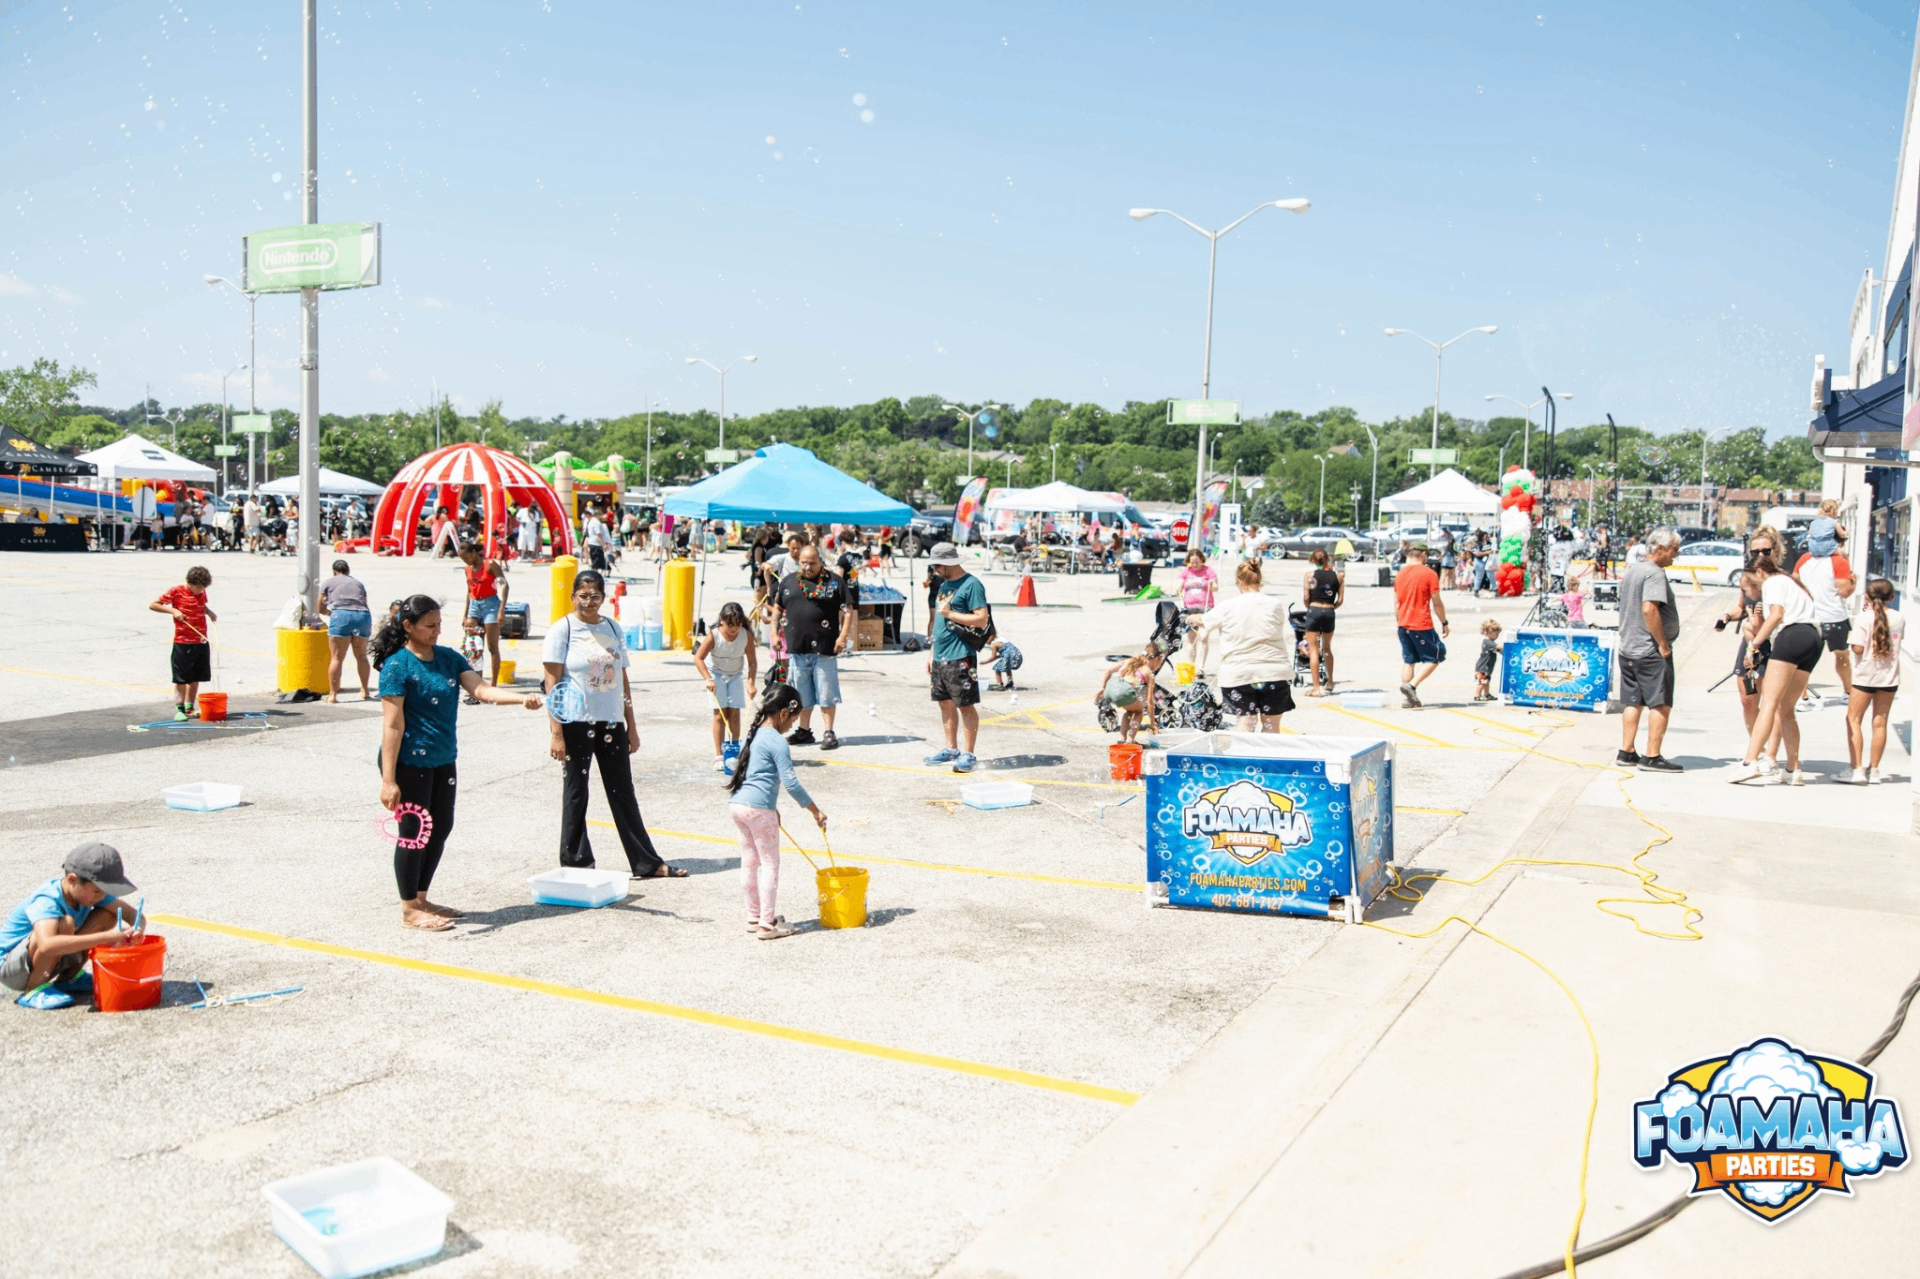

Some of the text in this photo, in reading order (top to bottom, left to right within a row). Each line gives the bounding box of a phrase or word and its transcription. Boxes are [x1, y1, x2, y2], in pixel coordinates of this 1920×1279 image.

[265, 247, 329, 266] Nintendo
[1185, 806, 1312, 845] FOAMAHA
[1226, 833, 1269, 846] PARTIES
[1190, 872, 1307, 892] FOAMAHAPARTIES.COM
[1211, 893, 1284, 910] 402-681-7127
